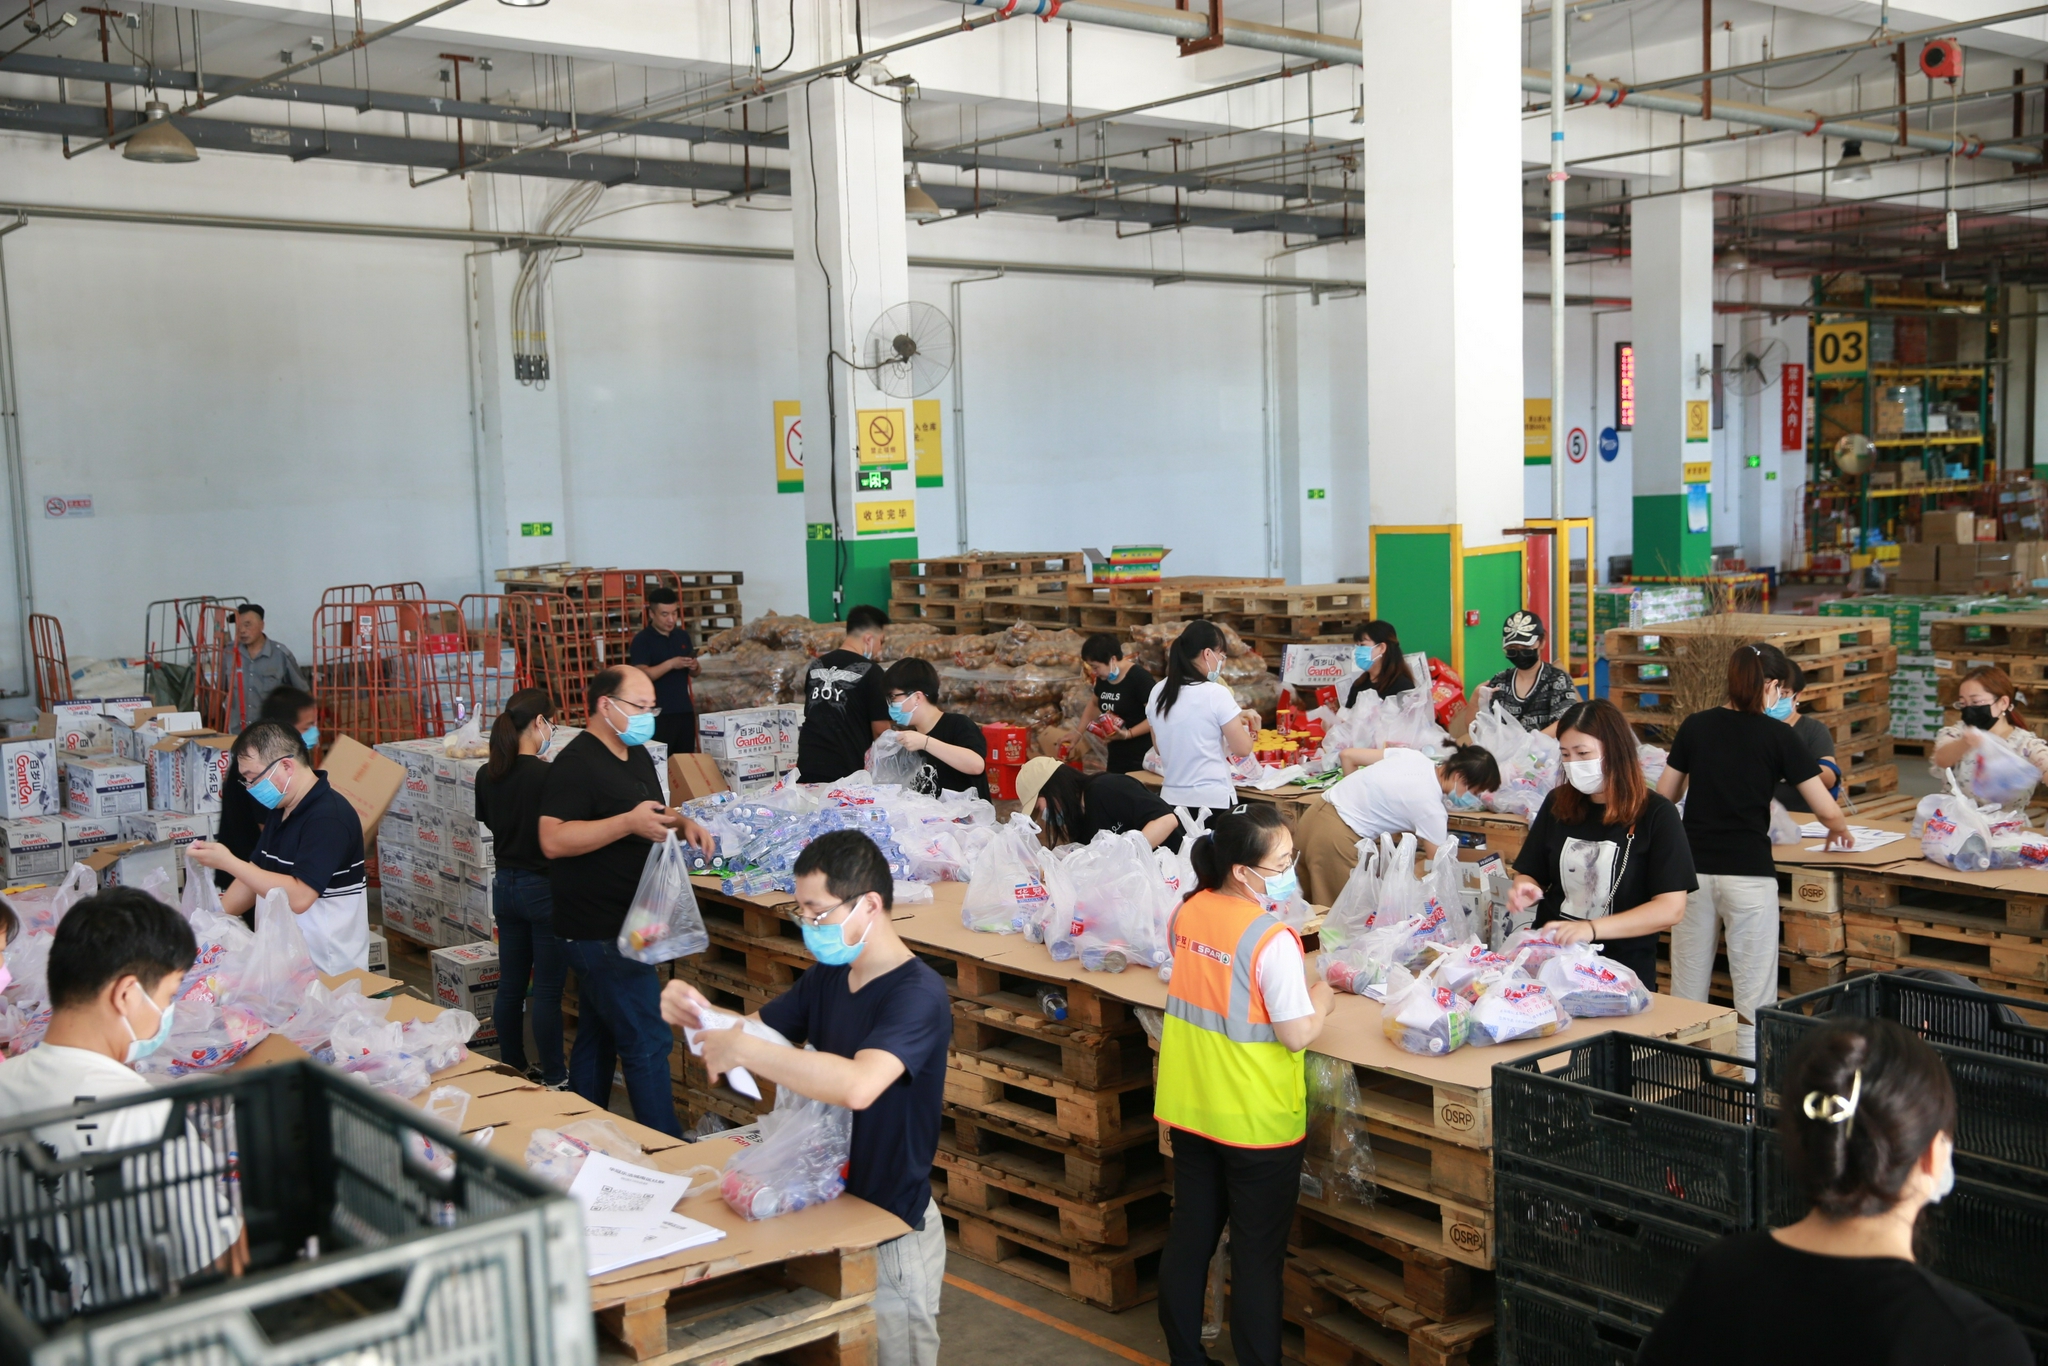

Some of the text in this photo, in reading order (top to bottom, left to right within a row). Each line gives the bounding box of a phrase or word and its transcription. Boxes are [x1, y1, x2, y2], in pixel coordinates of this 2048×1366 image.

[1819, 331, 1862, 364] 03
[1572, 436, 1581, 455] 5
[863, 509, 907, 521] 收货完毕
[1308, 666, 1342, 676] Ganten
[811, 687, 843, 702] BOY
[1100, 692, 1121, 701] GIRLS
[1101, 703, 1115, 711] ON
[741, 727, 763, 737] 百岁山
[736, 733, 772, 747] Ganten
[16, 755, 33, 805] Ganten
[30, 760, 41, 791] 百岁山
[209, 761, 218, 794] 百岁山
[406, 777, 429, 792] Ganten
[1802, 887, 1824, 898] DSRP
[1197, 945, 1221, 960] SPAR
[437, 983, 460, 1004] Ganten
[1445, 1108, 1472, 1125] DSRP
[1454, 1229, 1480, 1246] DSRP
